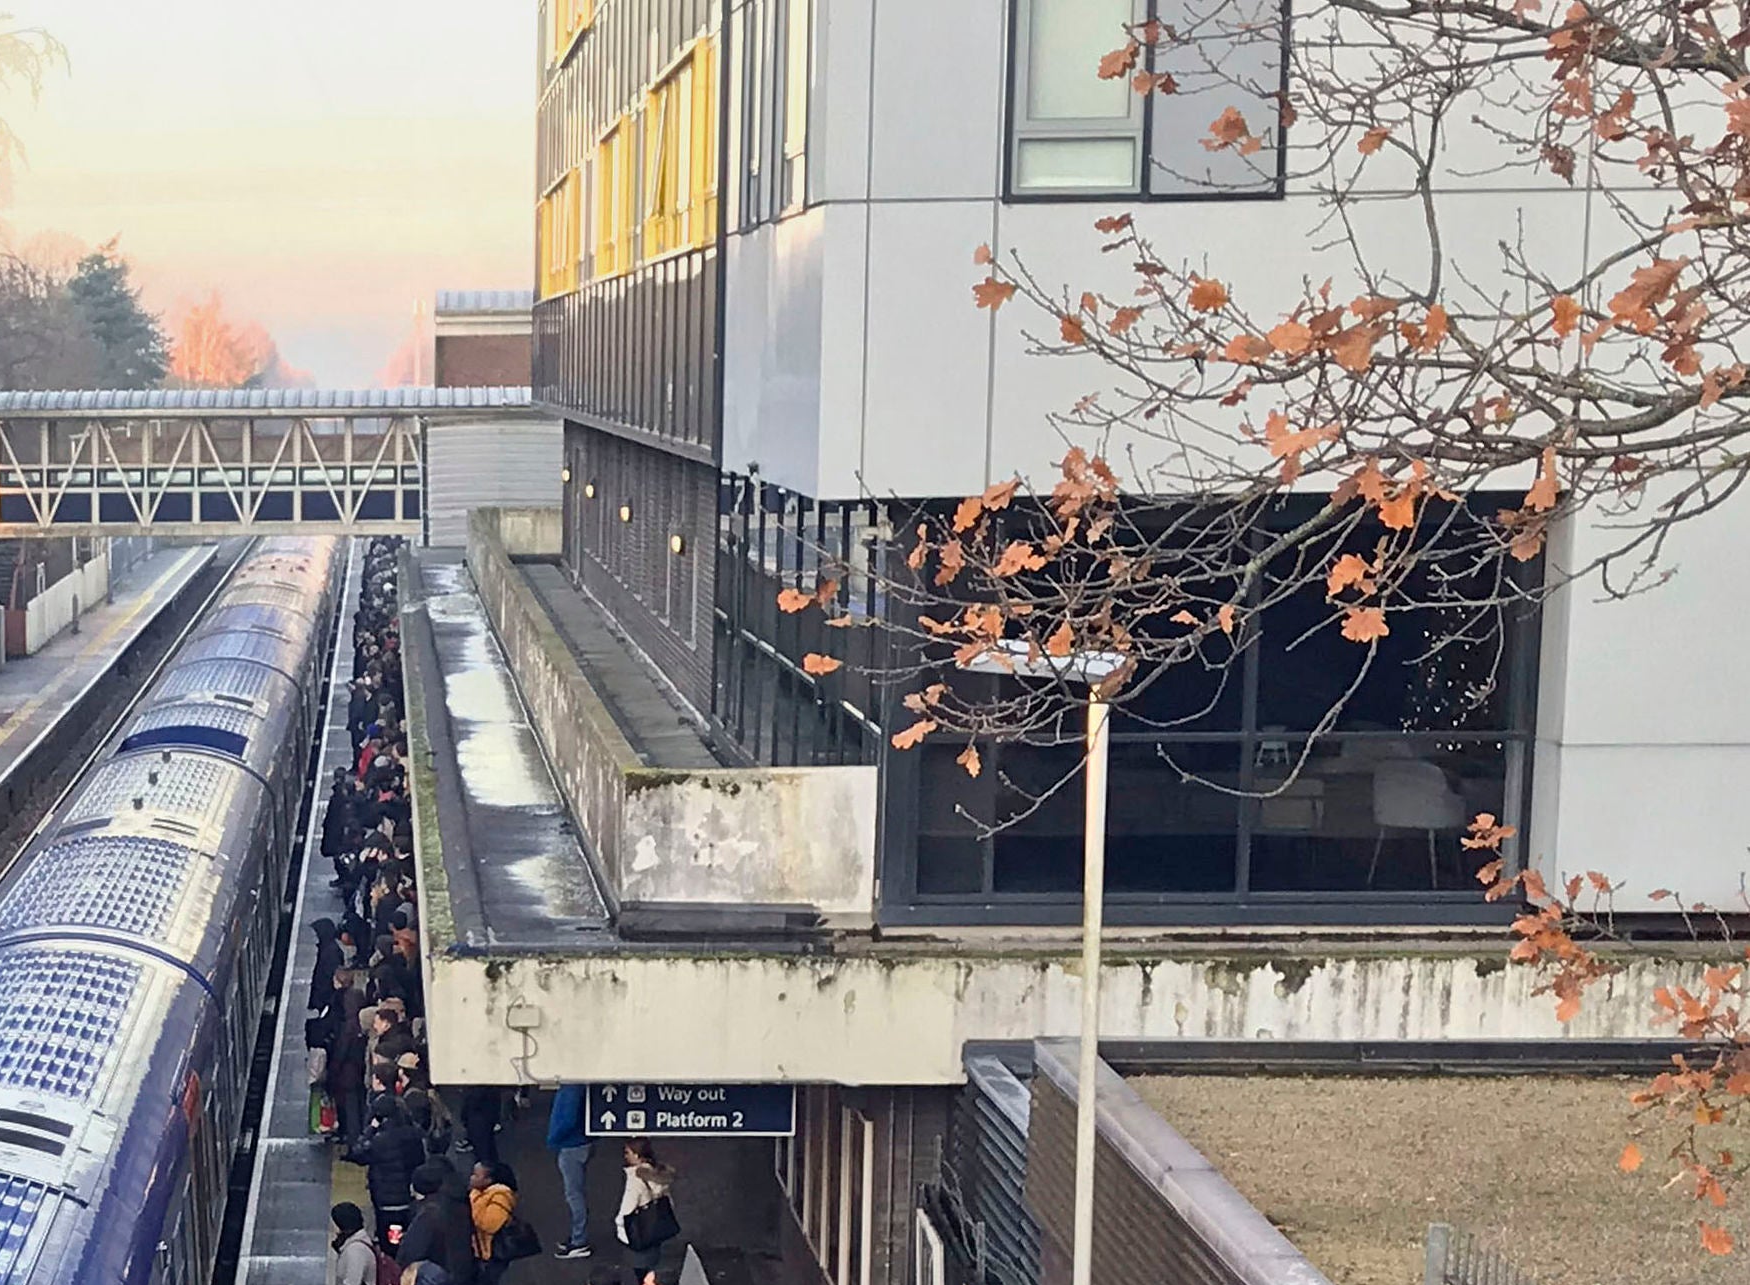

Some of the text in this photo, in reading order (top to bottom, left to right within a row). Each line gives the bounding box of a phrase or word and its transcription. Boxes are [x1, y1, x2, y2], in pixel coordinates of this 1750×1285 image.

[657, 1086, 727, 1105] Way out
[656, 1111, 744, 1128] Platform 2
